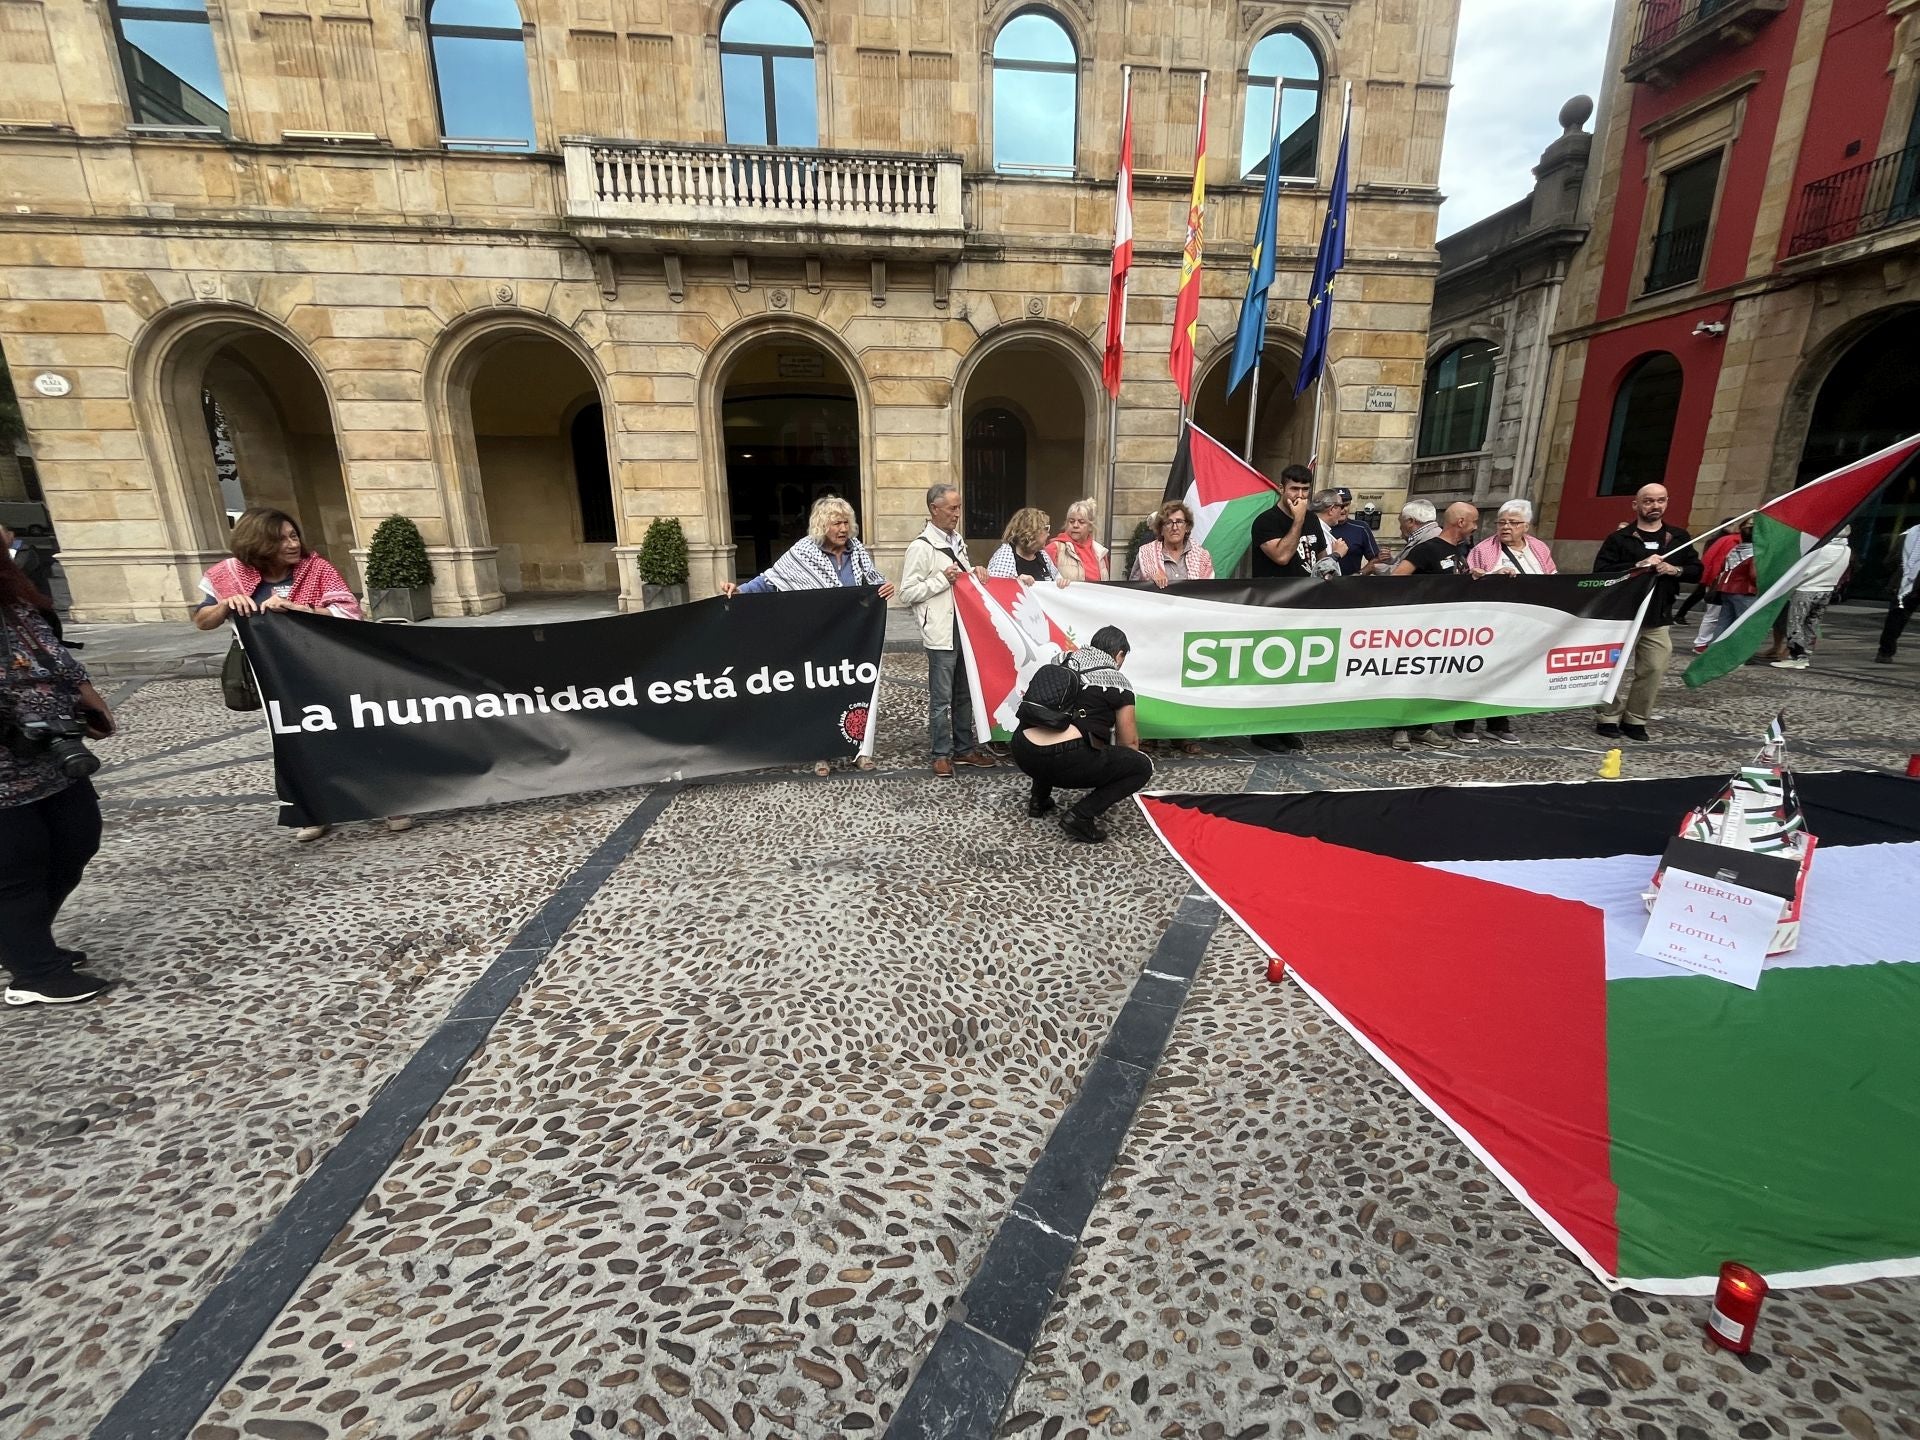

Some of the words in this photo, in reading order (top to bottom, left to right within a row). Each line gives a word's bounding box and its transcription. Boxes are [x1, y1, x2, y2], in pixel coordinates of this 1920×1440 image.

[1349, 626, 1495, 650] GENOCIDIO
[1184, 635, 1335, 681] STOP
[1345, 654, 1485, 677] PALESTINO
[1551, 650, 1606, 668] CCOO
[1568, 680, 1598, 689] comarcal
[1569, 672, 1600, 681] comarcal
[269, 699, 337, 735] La
[349, 676, 640, 729] humanidad
[647, 666, 738, 705] está
[745, 665, 796, 696] de
[803, 658, 879, 690] luto
[1684, 880, 1753, 906] LIBERTAD
[1684, 904, 1694, 913] A
[1710, 911, 1728, 924] LA
[1668, 922, 1737, 949] FLOTILLA
[1668, 943, 1687, 952] DE
[1703, 953, 1722, 964] LA
